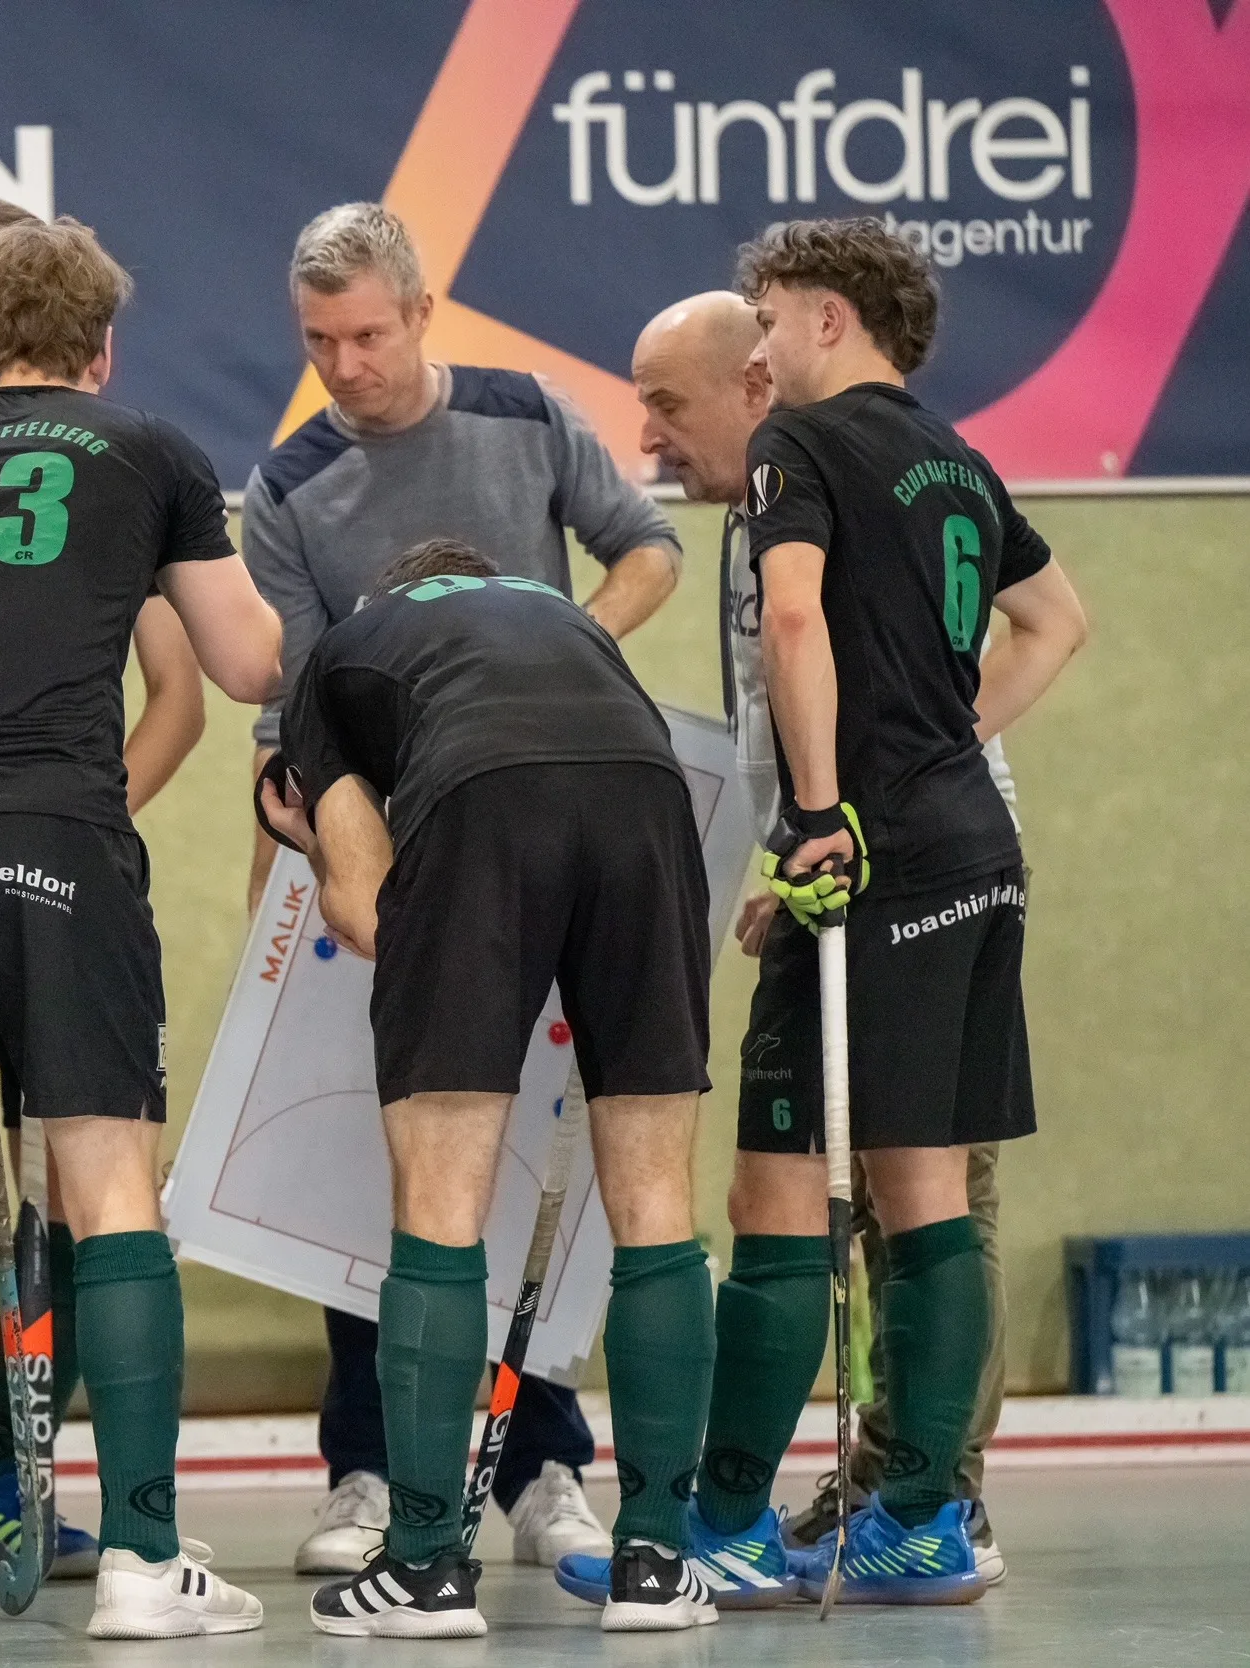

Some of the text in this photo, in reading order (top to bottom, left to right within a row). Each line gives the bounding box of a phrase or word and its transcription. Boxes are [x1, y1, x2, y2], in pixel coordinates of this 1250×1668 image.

[553, 66, 1092, 204] fünfdrei
[893, 463, 927, 507] CLUB
[15, 551, 34, 560] CR
[943, 514, 981, 652] 6
[260, 879, 308, 984] MALIK
[772, 1098, 792, 1130] 6
